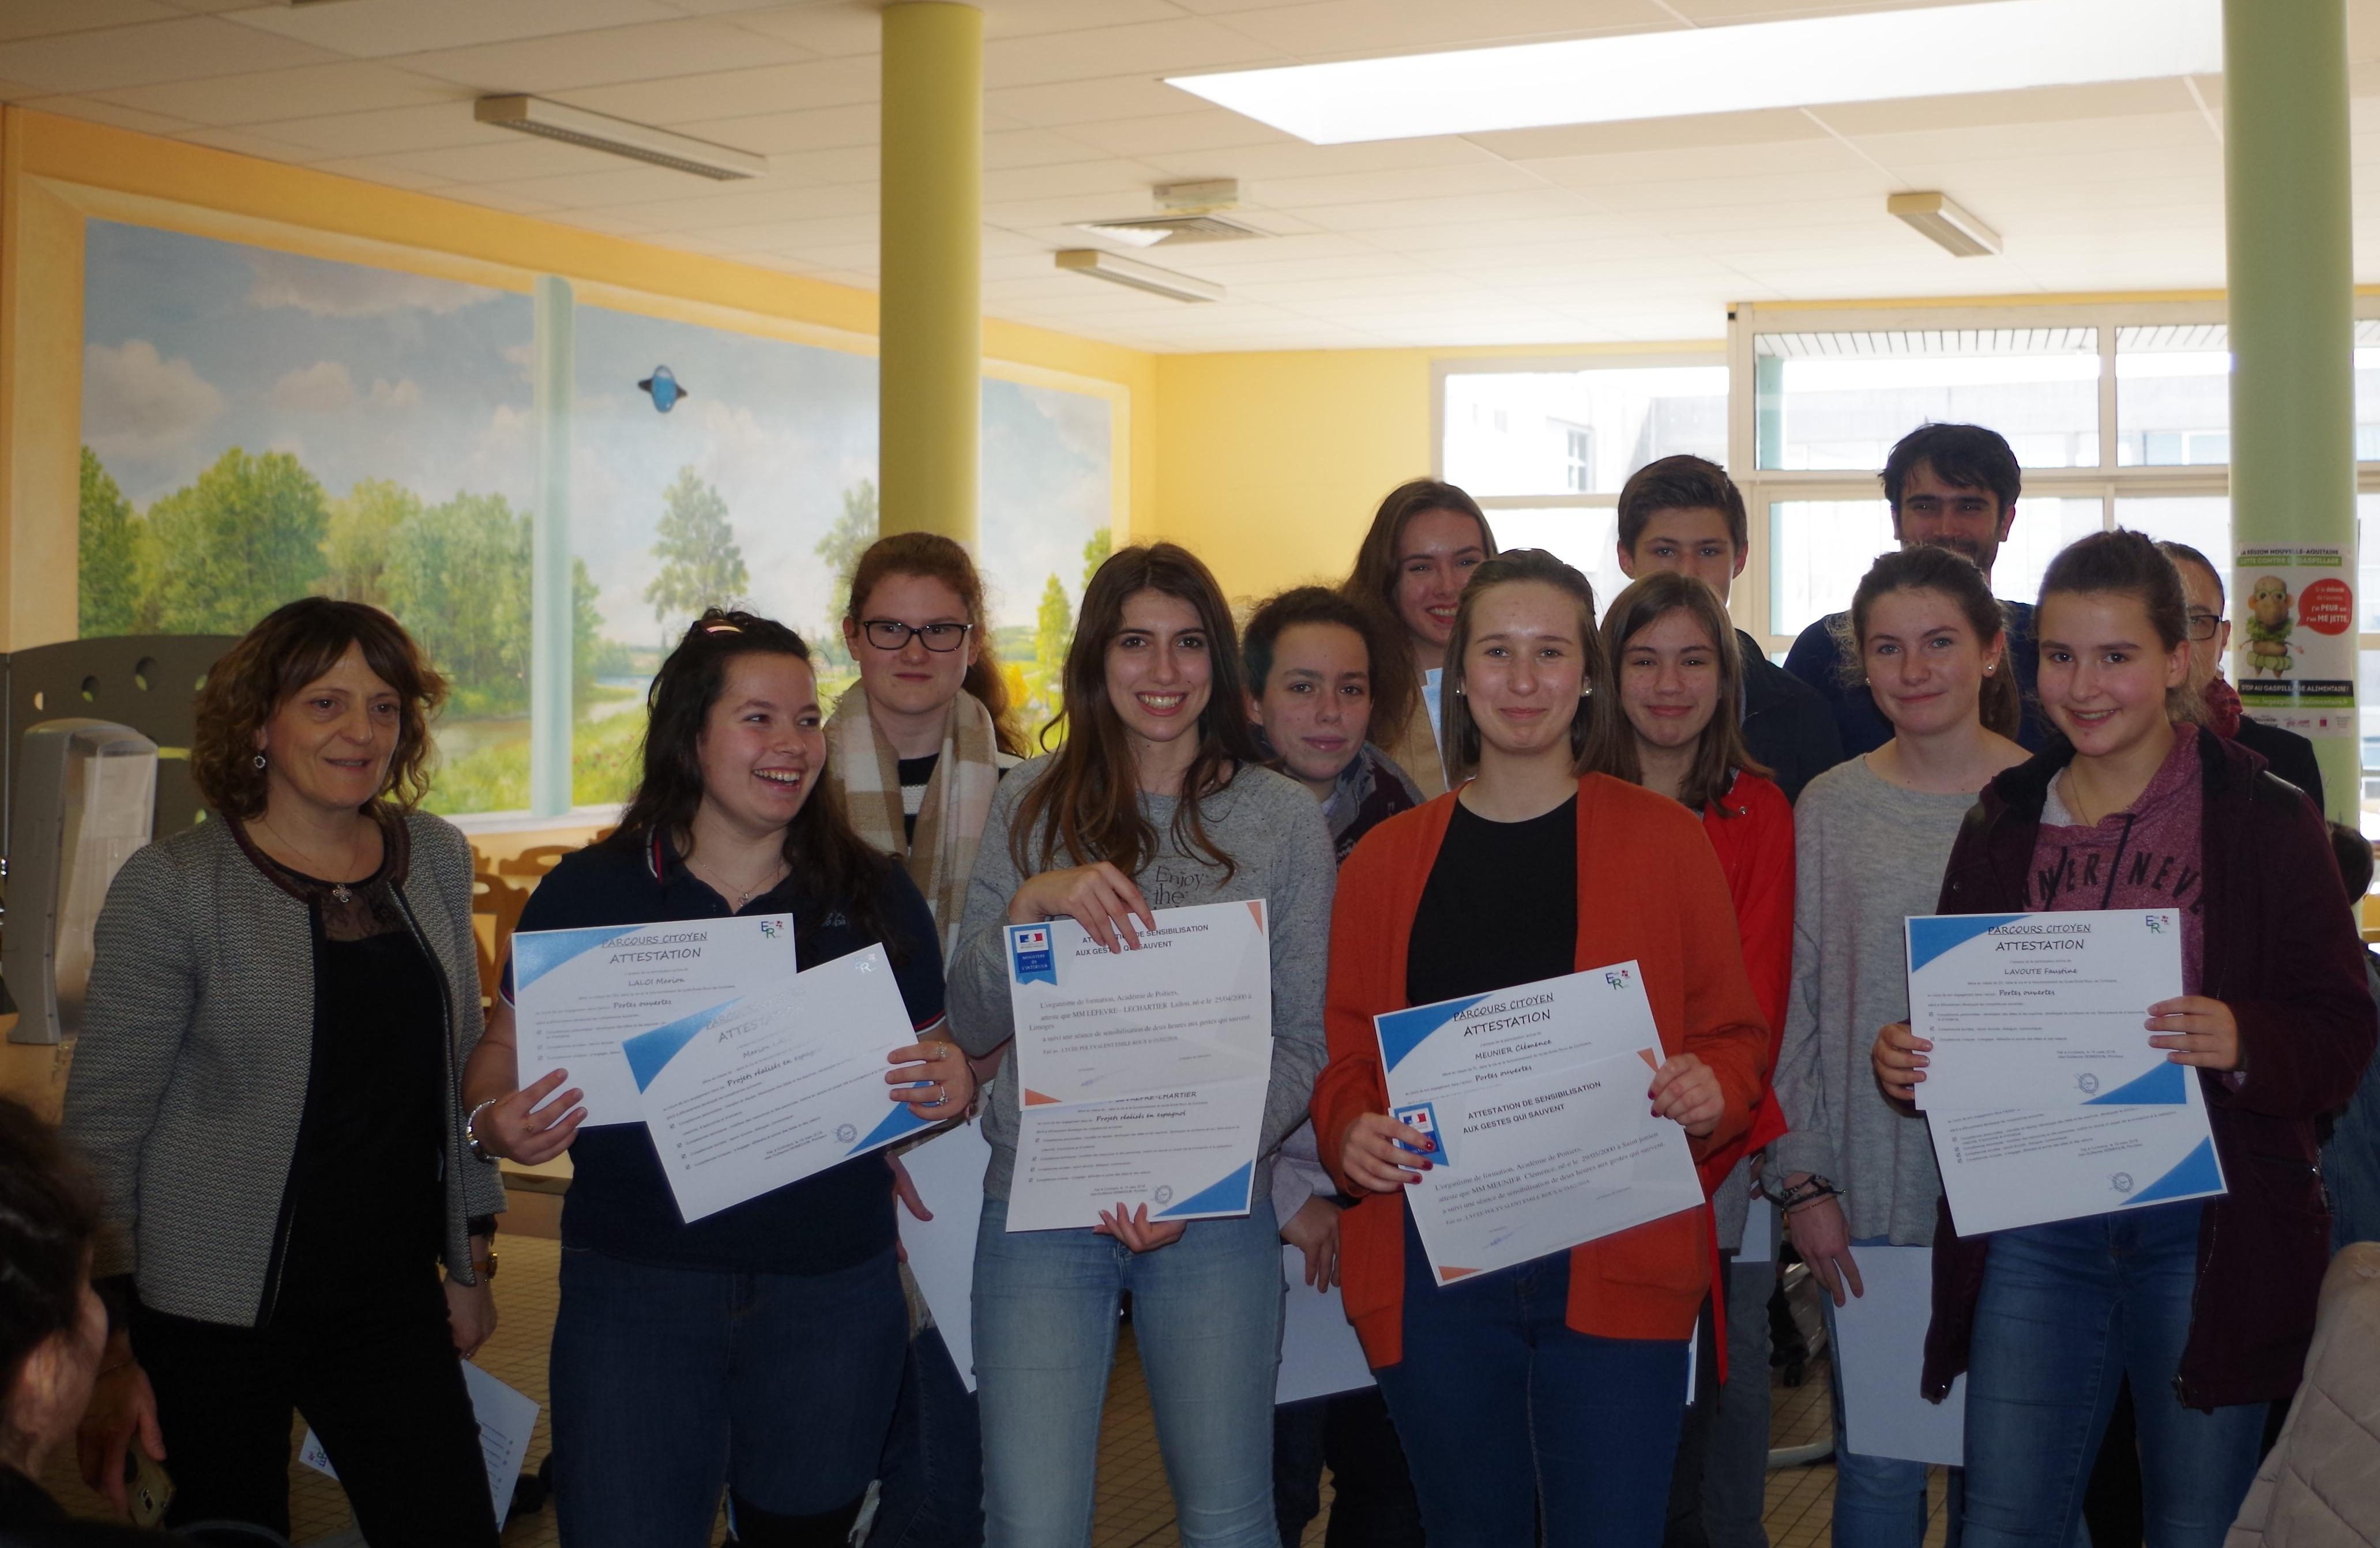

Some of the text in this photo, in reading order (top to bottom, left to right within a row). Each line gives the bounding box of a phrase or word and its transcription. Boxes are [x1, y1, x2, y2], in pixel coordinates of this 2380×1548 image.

[1155, 865, 1201, 890] Enjoy
[1154, 883, 1186, 906] the
[1146, 924, 1209, 937] SENSIBILISATION
[1988, 924, 2091, 935] PARCOURS CITOYEN
[601, 932, 708, 947] PARCOURS CITOYEN
[1138, 941, 1172, 950] SAUVENT
[1995, 939, 2084, 951] ATTESTATION
[610, 947, 701, 964] ATTESTATION
[629, 978, 654, 986] LALOI
[1124, 1003, 1167, 1012] LECHARTIER
[1453, 992, 1555, 1021] PARCOURS CITOYEN
[1103, 1027, 1144, 1036] sensibilisation
[1199, 1019, 1217, 1027] gestes
[1464, 1008, 1550, 1037] ATTESTATION
[1475, 1046, 1513, 1060] MEUNIER
[1515, 1039, 1552, 1052] Clémence
[727, 1074, 753, 1087] Projets
[754, 1064, 781, 1076] réalisés
[1475, 1073, 1498, 1082] Portes
[1500, 1065, 1532, 1076] ouvertes
[1468, 1081, 1601, 1120] ATTESTATION DE SENSIBILISATION
[1156, 1110, 1186, 1118] espagnol
[1463, 1103, 1564, 1134] AUX GESTES QUI SAUVENT
[1435, 1178, 1473, 1192] L'organisme
[1517, 1158, 1547, 1170] Académie
[1439, 1194, 1458, 1203] atteste
[1458, 1191, 1471, 1199] que
[1472, 1185, 1486, 1193] MM
[1486, 1176, 1521, 1189] MEUNIER
[1621, 1139, 1638, 1148] Saint
[1476, 1195, 1497, 1205] séance
[1506, 1180, 1550, 1196] sensibilisation
[1559, 1173, 1575, 1181] deux
[1575, 1166, 1596, 1177] heures
[1610, 1155, 1629, 1166] gestes
[1629, 1150, 1640, 1158] qui
